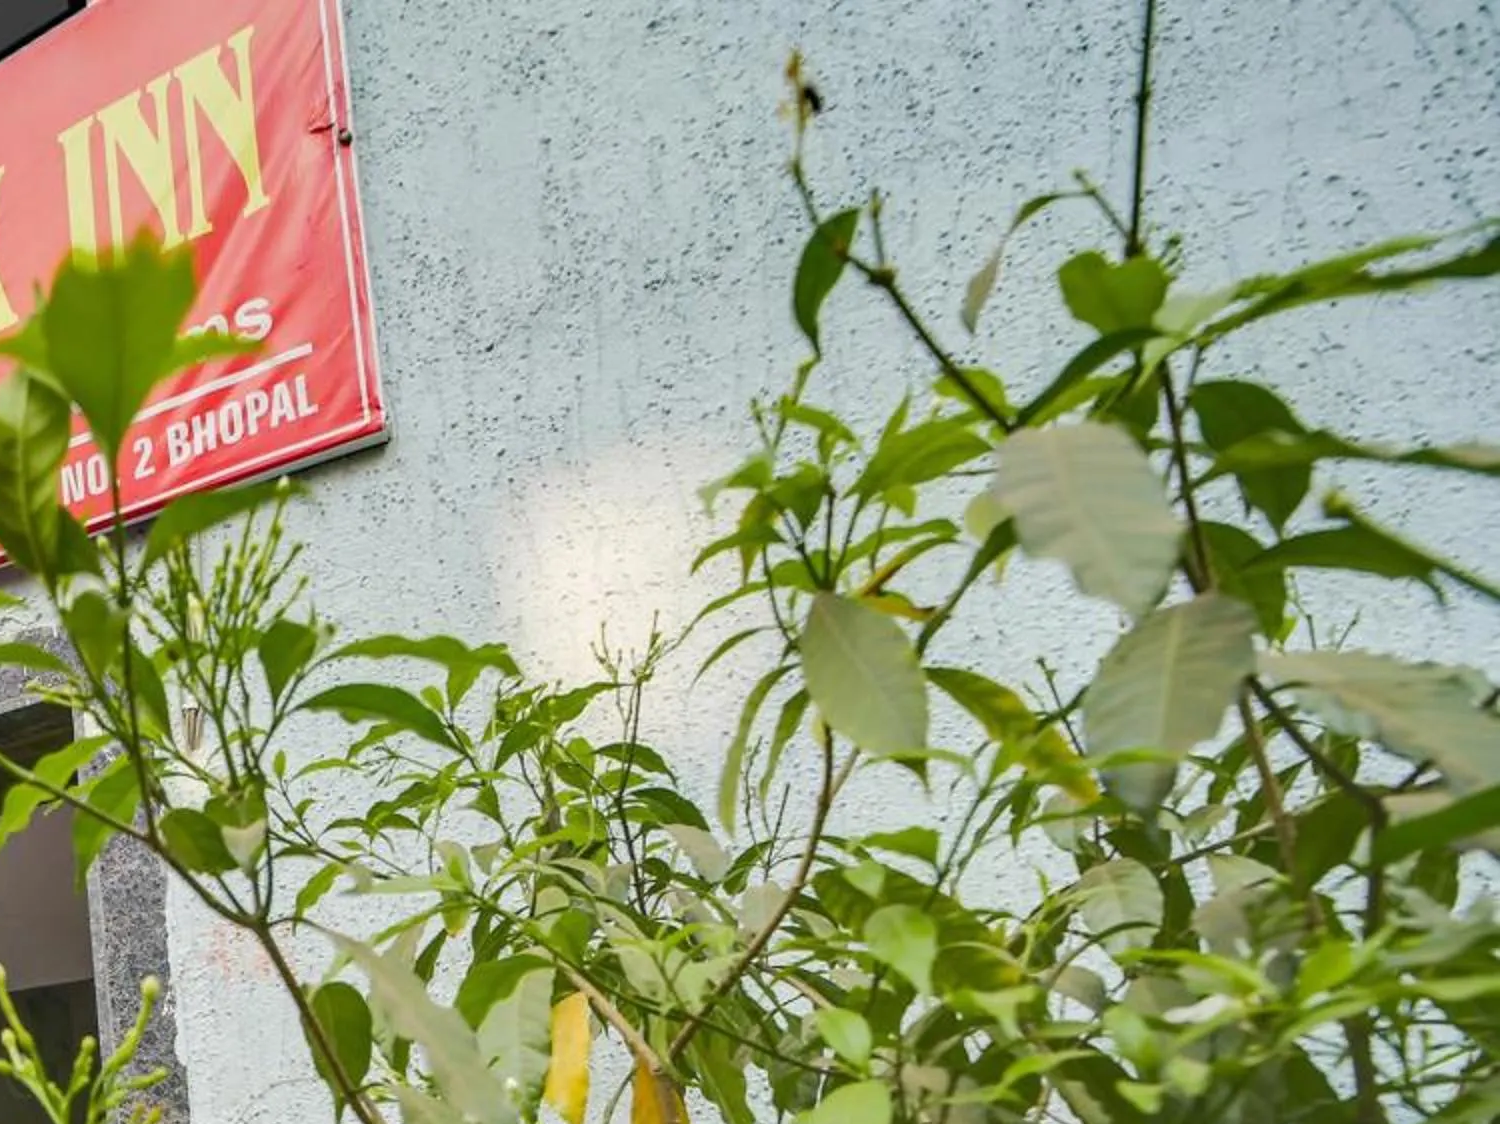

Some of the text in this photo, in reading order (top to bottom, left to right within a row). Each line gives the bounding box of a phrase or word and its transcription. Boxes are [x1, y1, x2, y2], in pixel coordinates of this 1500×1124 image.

[57, 25, 270, 271] INN
[132, 436, 156, 481] 2
[165, 373, 319, 469] BHOPAL
